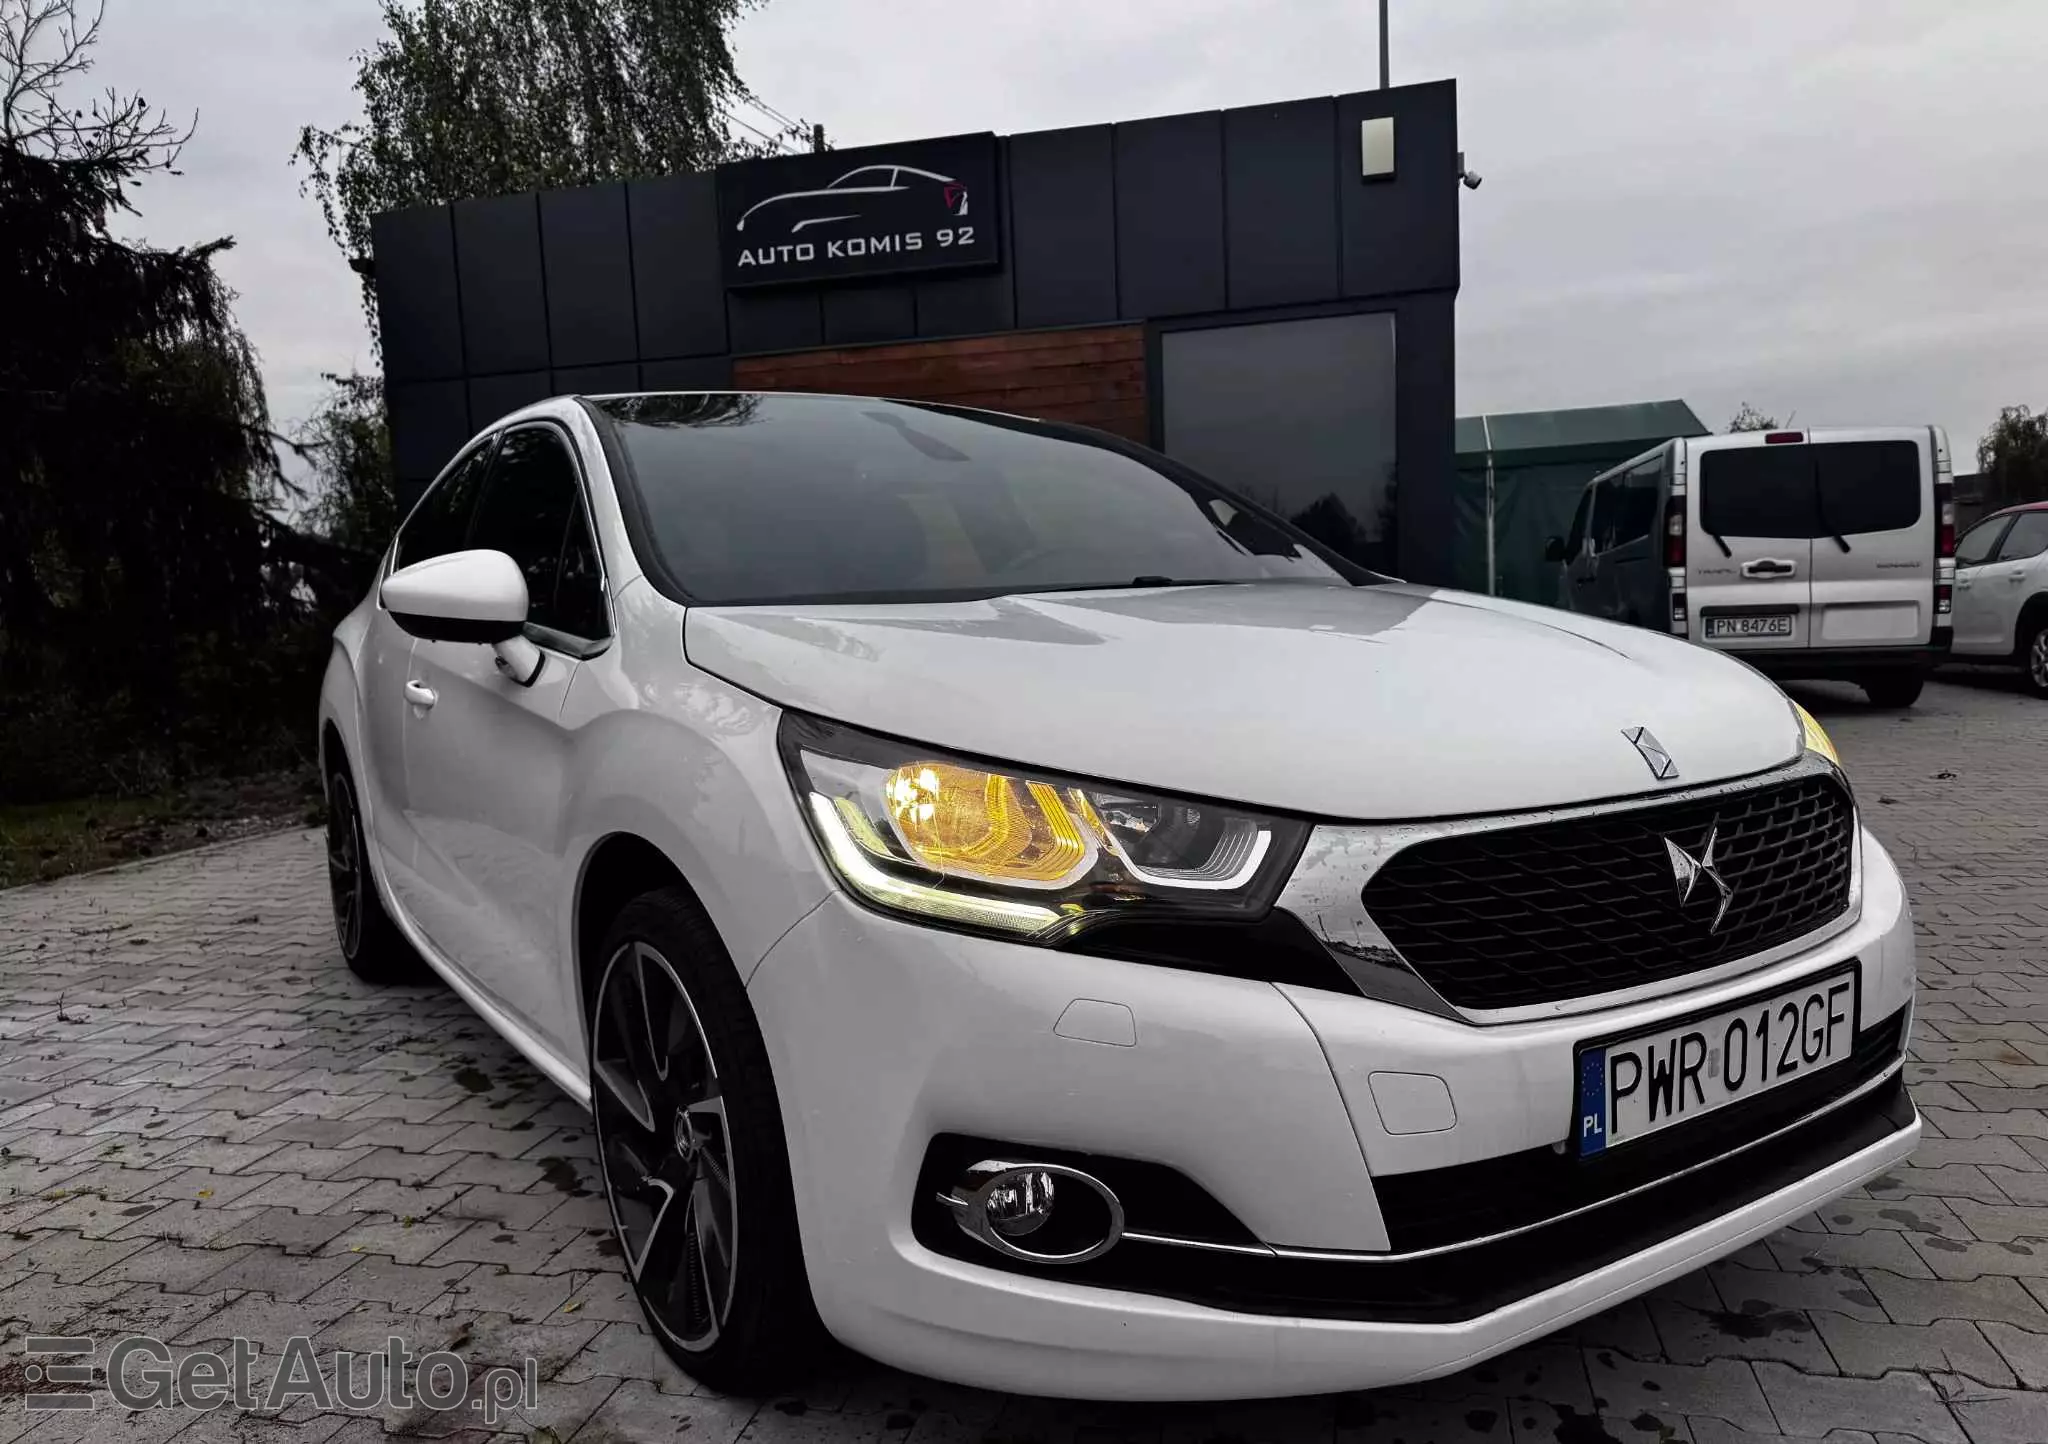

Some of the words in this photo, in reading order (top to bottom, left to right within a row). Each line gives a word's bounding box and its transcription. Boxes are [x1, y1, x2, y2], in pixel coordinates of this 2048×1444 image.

[738, 243, 814, 267] AUTO
[827, 232, 922, 259] KOMIS
[937, 226, 975, 247] 92
[1717, 619, 1737, 633] PN
[1741, 618, 1787, 633] 8476E
[1609, 1031, 1706, 1135] PWR
[1722, 982, 1850, 1092] 012GF
[1583, 1112, 1603, 1138] PL
